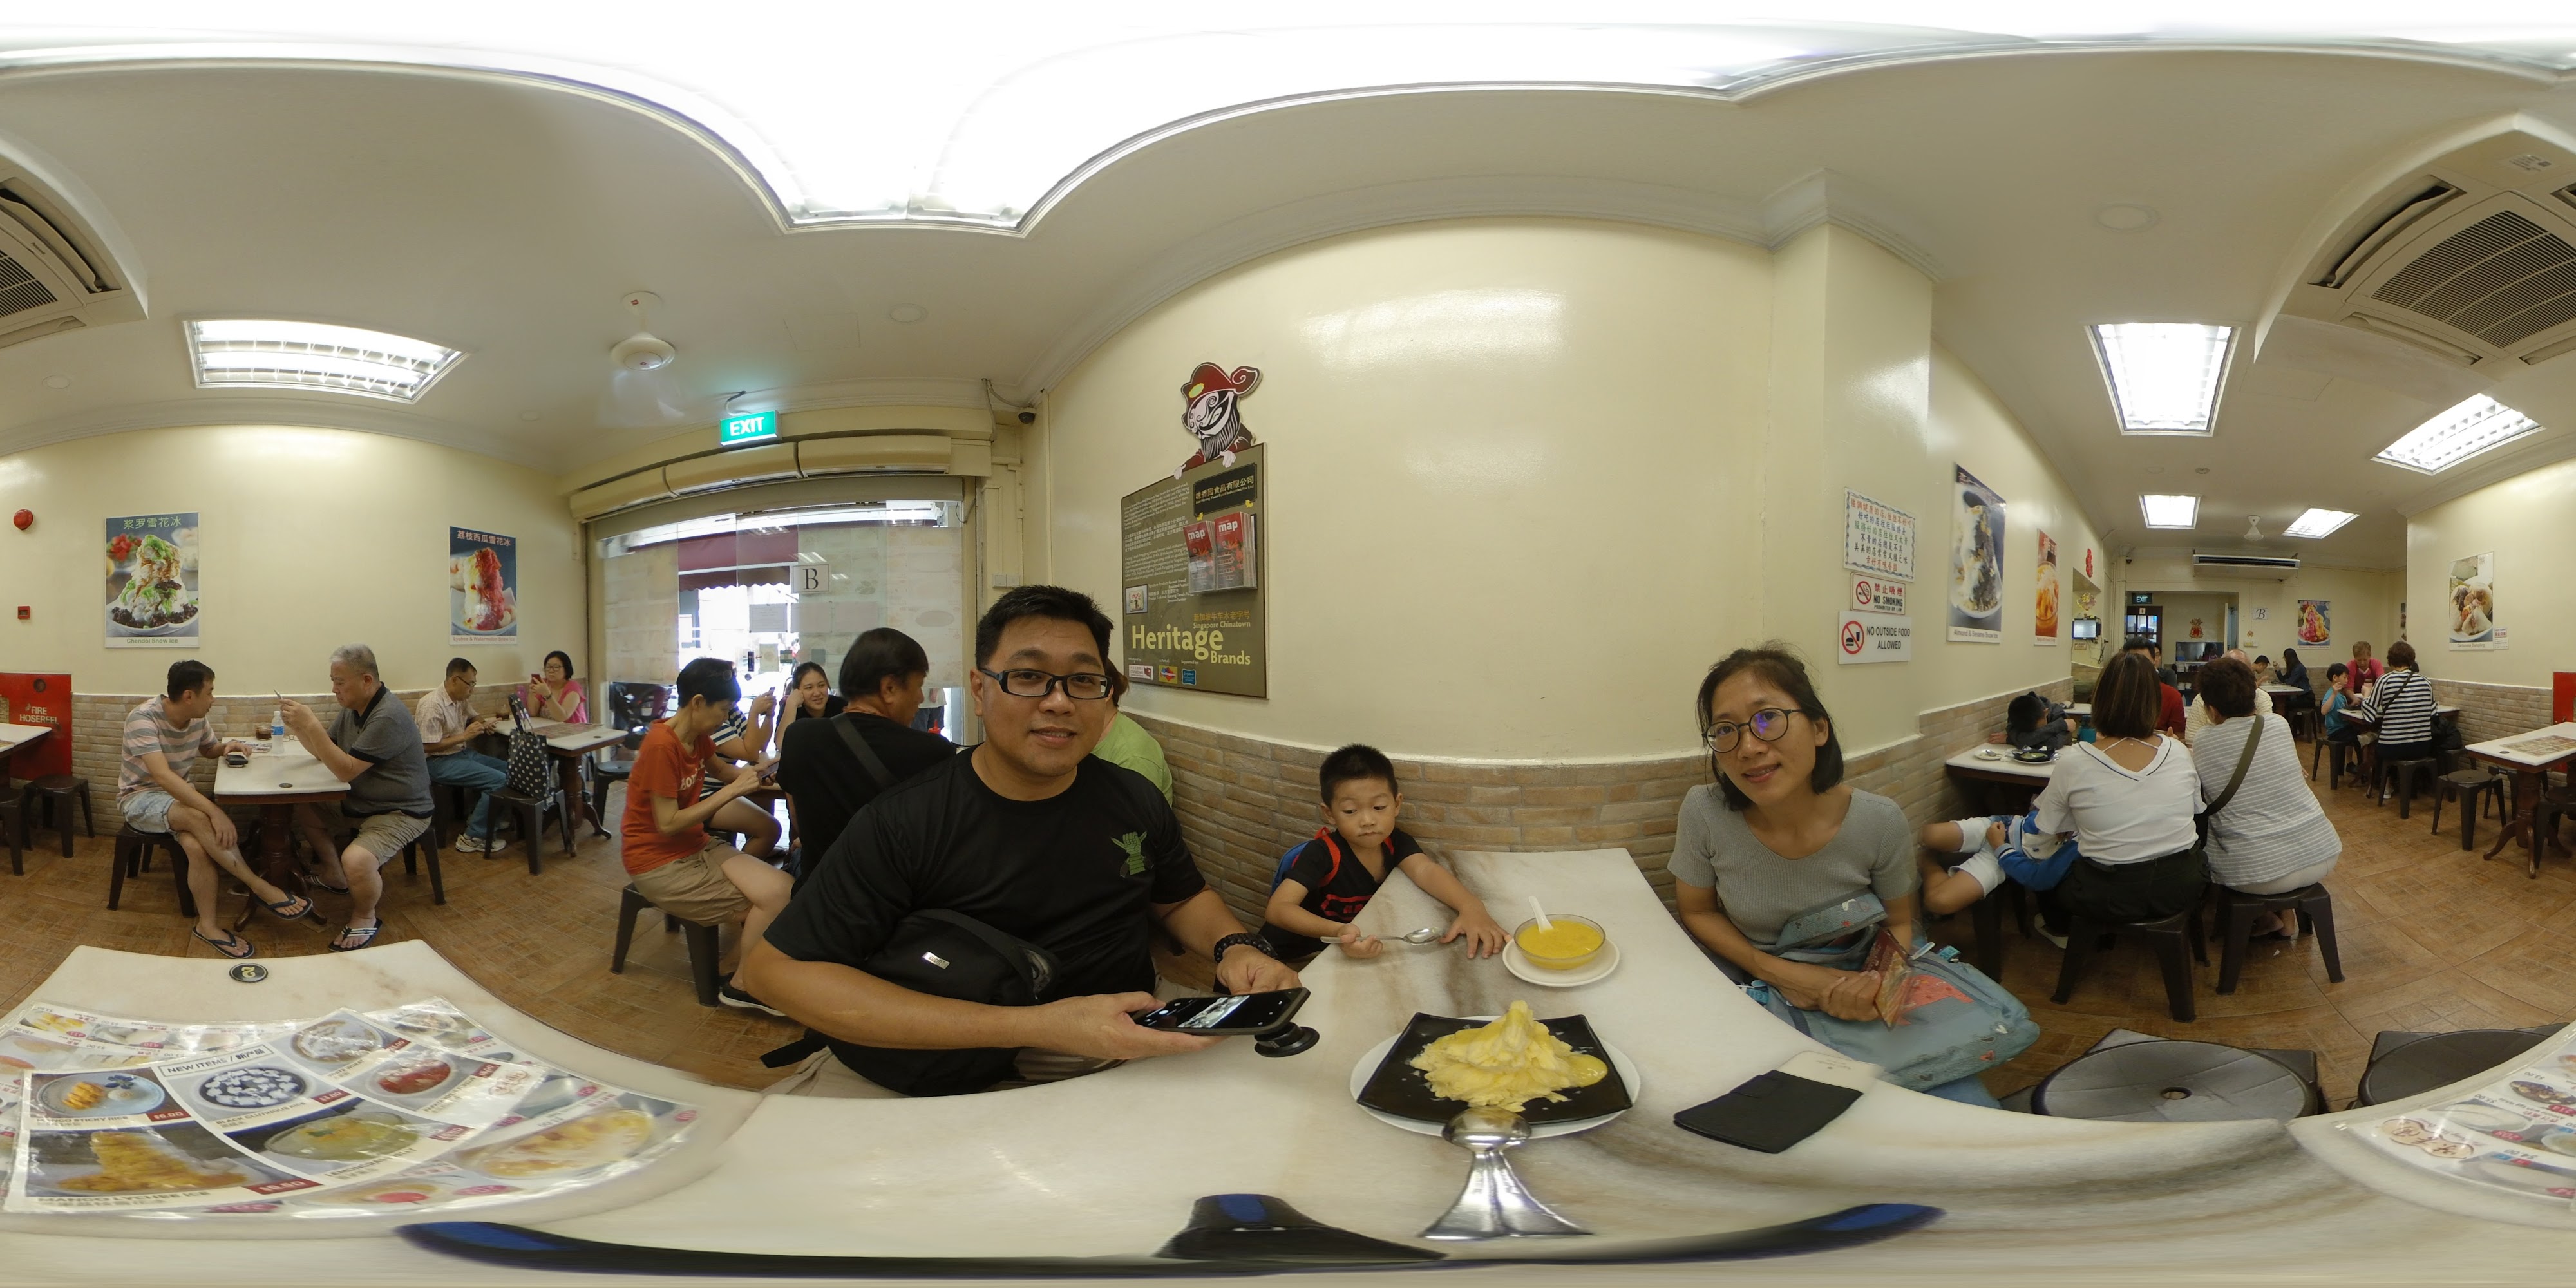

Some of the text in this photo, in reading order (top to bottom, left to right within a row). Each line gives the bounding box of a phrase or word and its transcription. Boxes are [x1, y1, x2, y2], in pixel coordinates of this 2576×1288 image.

[729, 417, 765, 436] EXIT
[1218, 520, 1238, 533] map
[457, 530, 511, 547] 荔枝西瓜雪花冰
[1188, 529, 1206, 540] map
[803, 568, 819, 590] B
[1875, 583, 1903, 596] 禁止吸煙
[1873, 594, 1903, 607] NO SMOKING
[1193, 611, 1251, 622] 新加坡牛车水老字号
[2256, 609, 2266, 619] B
[1866, 626, 1911, 637] NO OUTSIDE FOOD
[1132, 623, 1224, 661] Heritage
[1877, 641, 1902, 650] ALLOWED
[1211, 650, 1251, 665] Brands
[31, 706, 48, 715] FIRE
[241, 966, 256, 978] 2
[167, 1064, 194, 1073] NEW
[196, 1057, 228, 1068] ITEMS
[236, 1048, 265, 1060] 新产品
[215, 1116, 244, 1125] BLACK
[245, 1106, 289, 1120] GLUTINOUS
